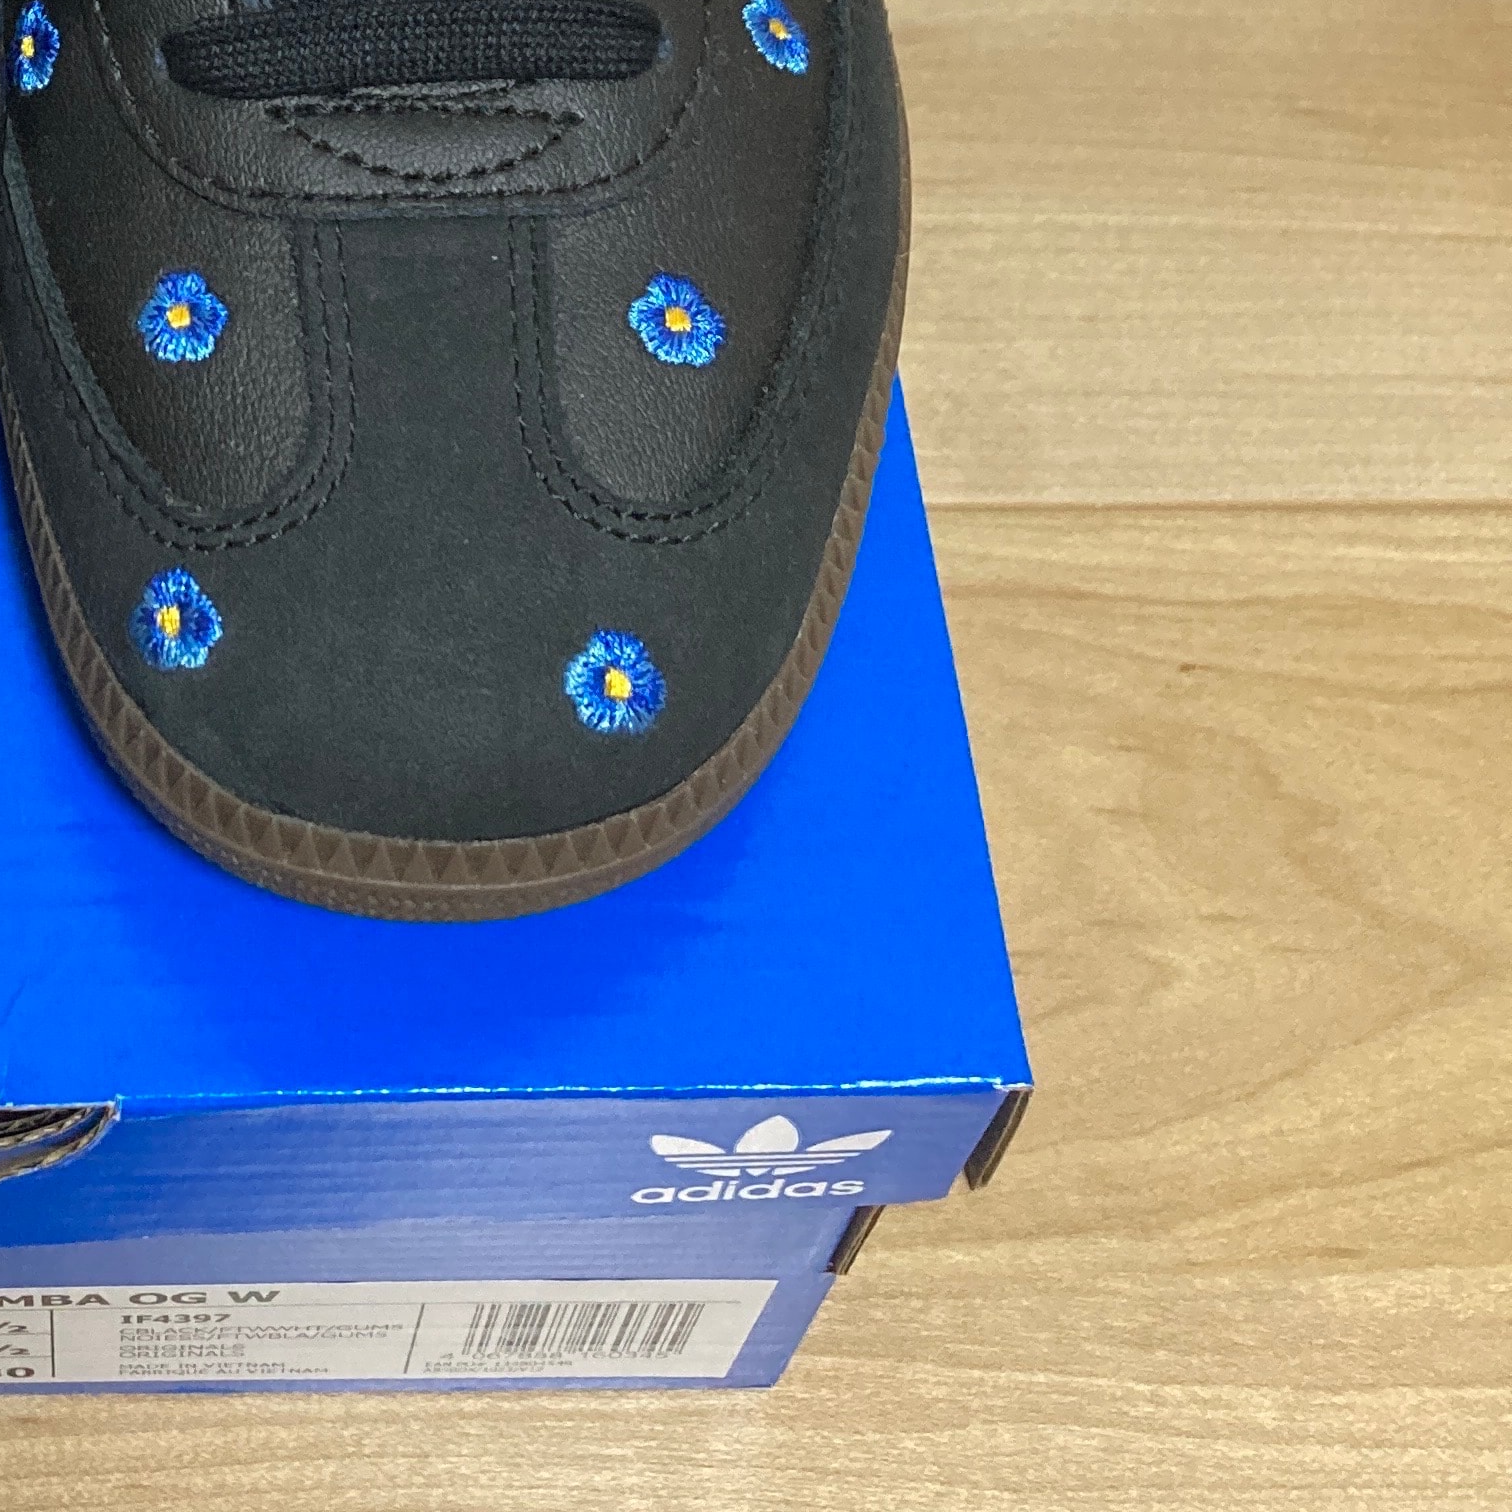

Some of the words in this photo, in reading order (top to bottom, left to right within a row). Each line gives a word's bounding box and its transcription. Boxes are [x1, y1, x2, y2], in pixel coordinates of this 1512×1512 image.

[630, 1178, 865, 1204] adidas
[128, 1292, 208, 1306] OG
[227, 1290, 281, 1304] W
[120, 1314, 233, 1325] IF4397
[119, 1343, 246, 1352] ORIGINALS
[119, 1350, 246, 1359] ORIGINALS
